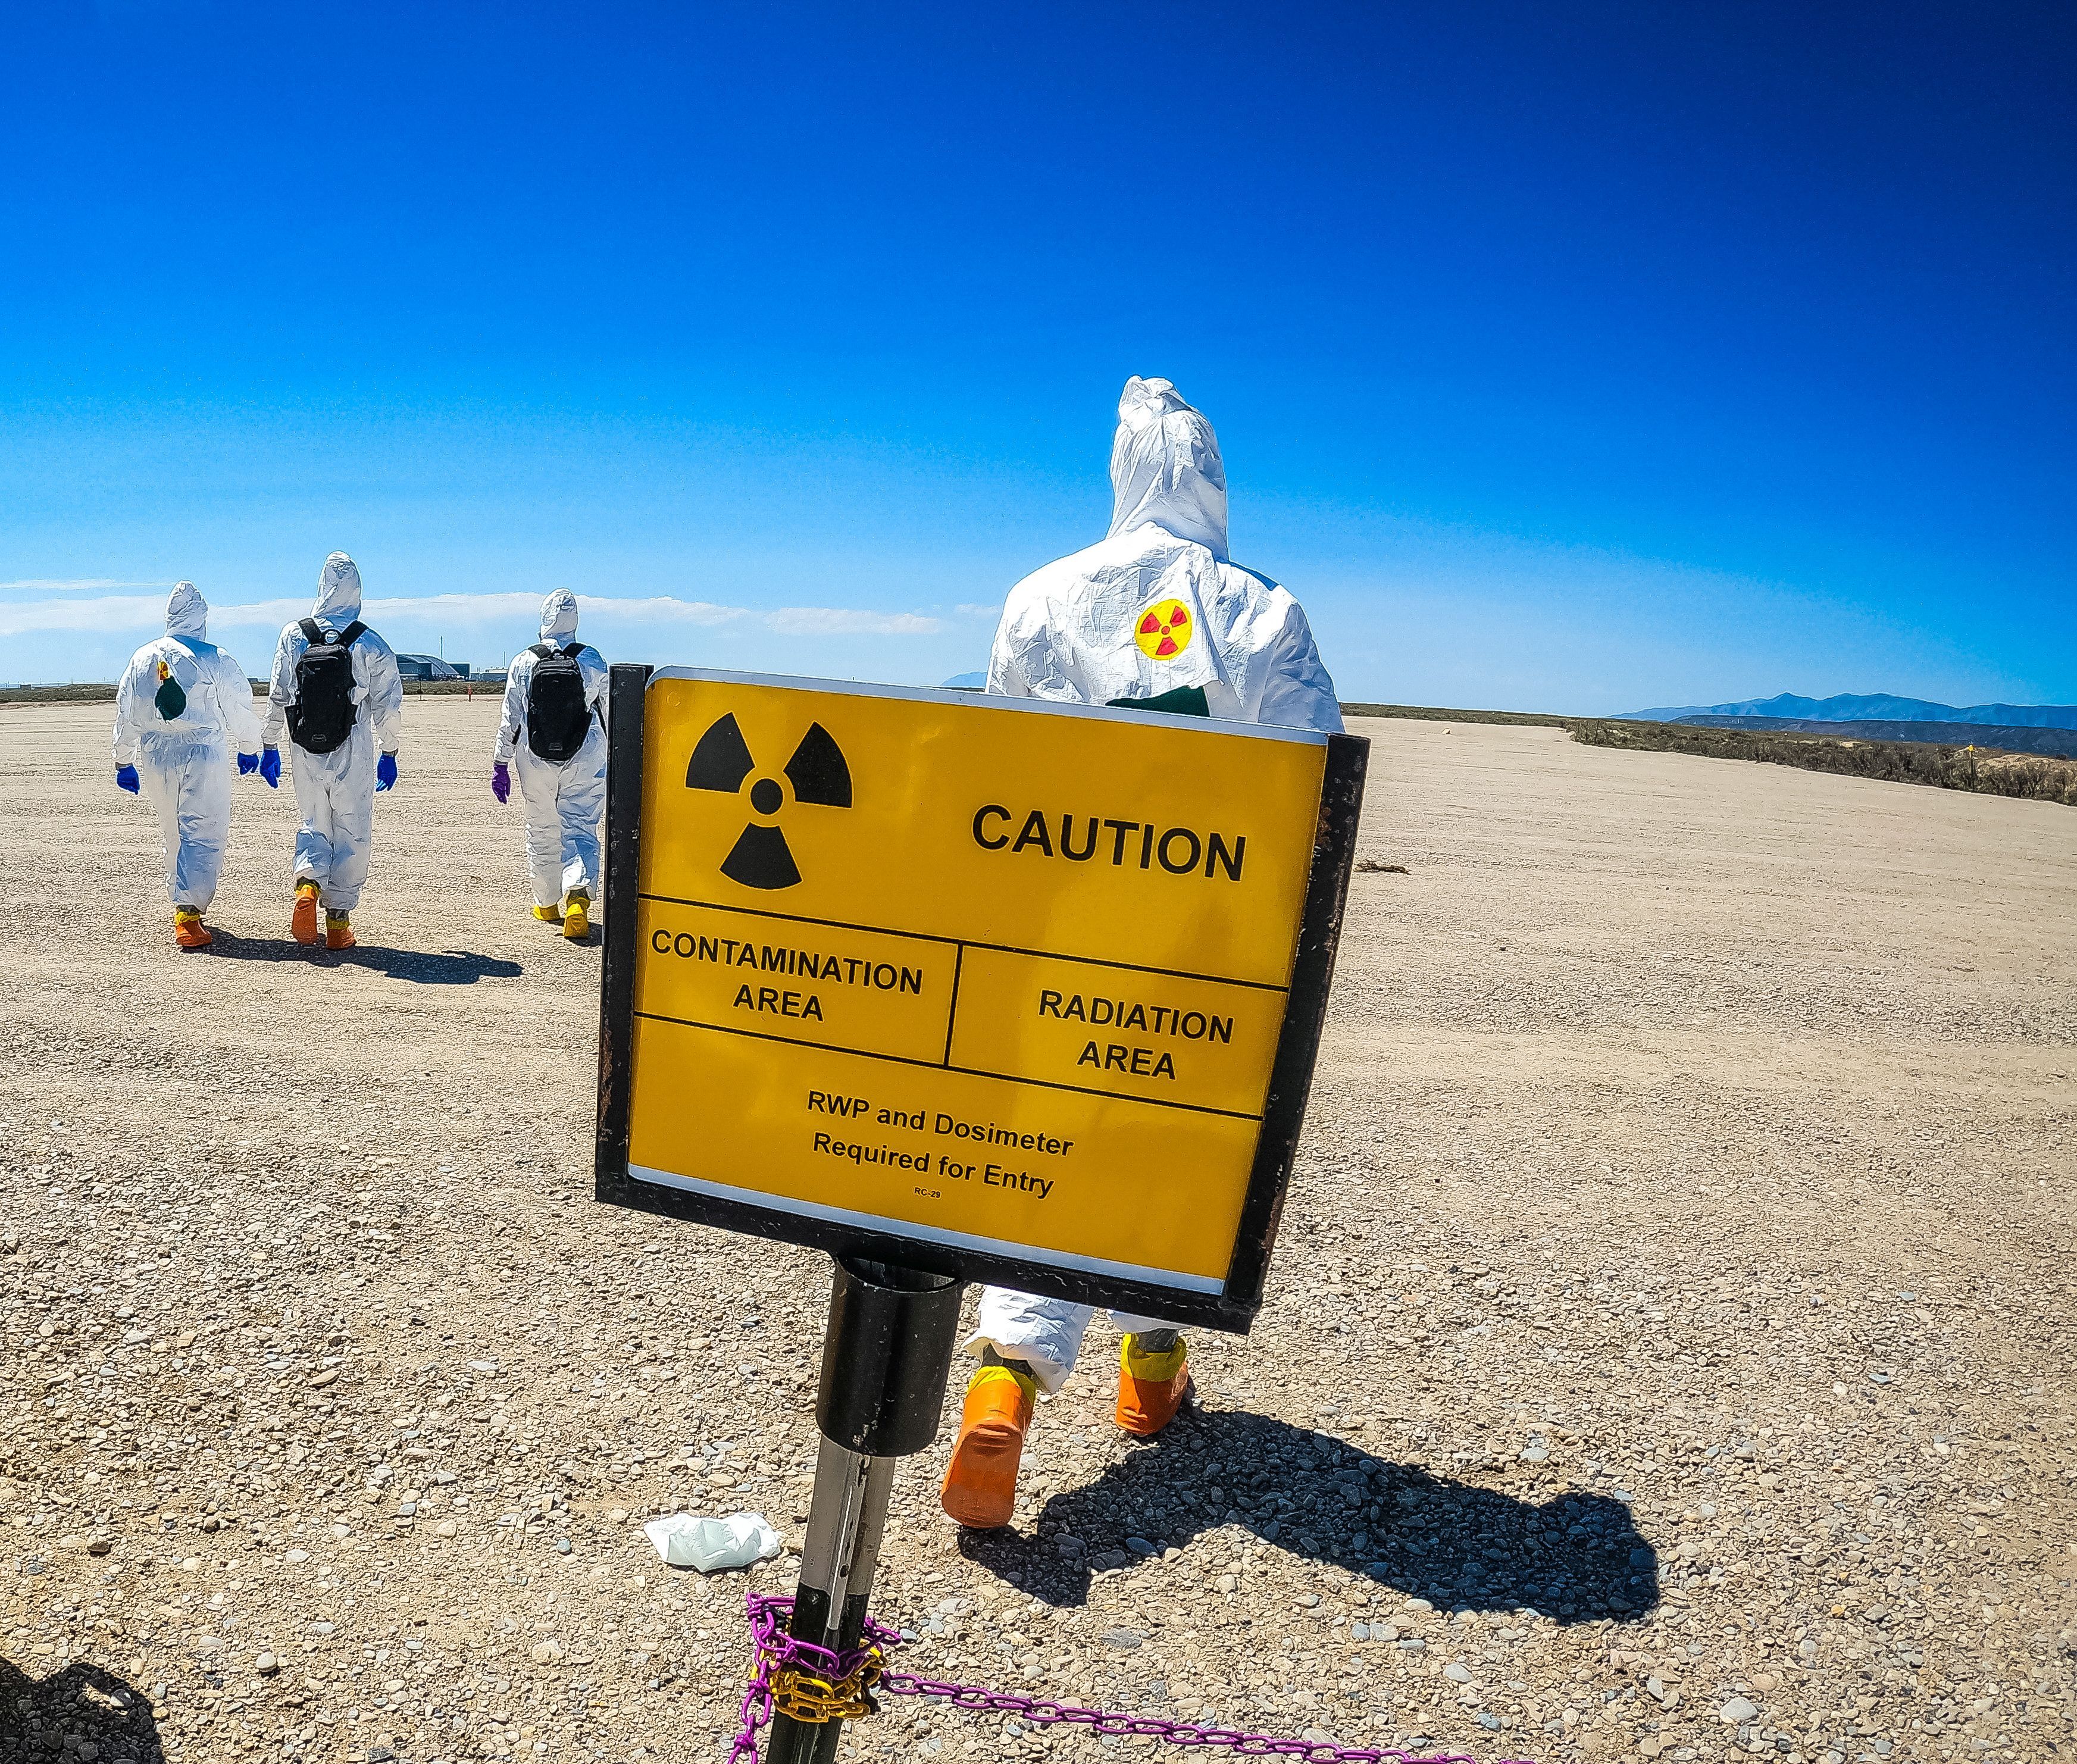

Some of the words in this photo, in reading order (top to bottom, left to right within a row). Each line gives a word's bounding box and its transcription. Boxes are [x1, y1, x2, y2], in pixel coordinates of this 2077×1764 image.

[972, 804, 1247, 882] CAUTION
[652, 929, 922, 995] CONTAMINATION
[733, 984, 824, 1022] AREA
[1038, 989, 1234, 1044] RADIATION
[1077, 1041, 1175, 1080] AREA
[808, 1090, 870, 1119] RWP
[877, 1109, 926, 1131] and
[934, 1113, 1074, 1156] Dosimeter
[814, 1132, 930, 1173] Required
[939, 1156, 977, 1181] for
[983, 1164, 1055, 1199] Entry
[914, 1187, 941, 1198] RC-29
